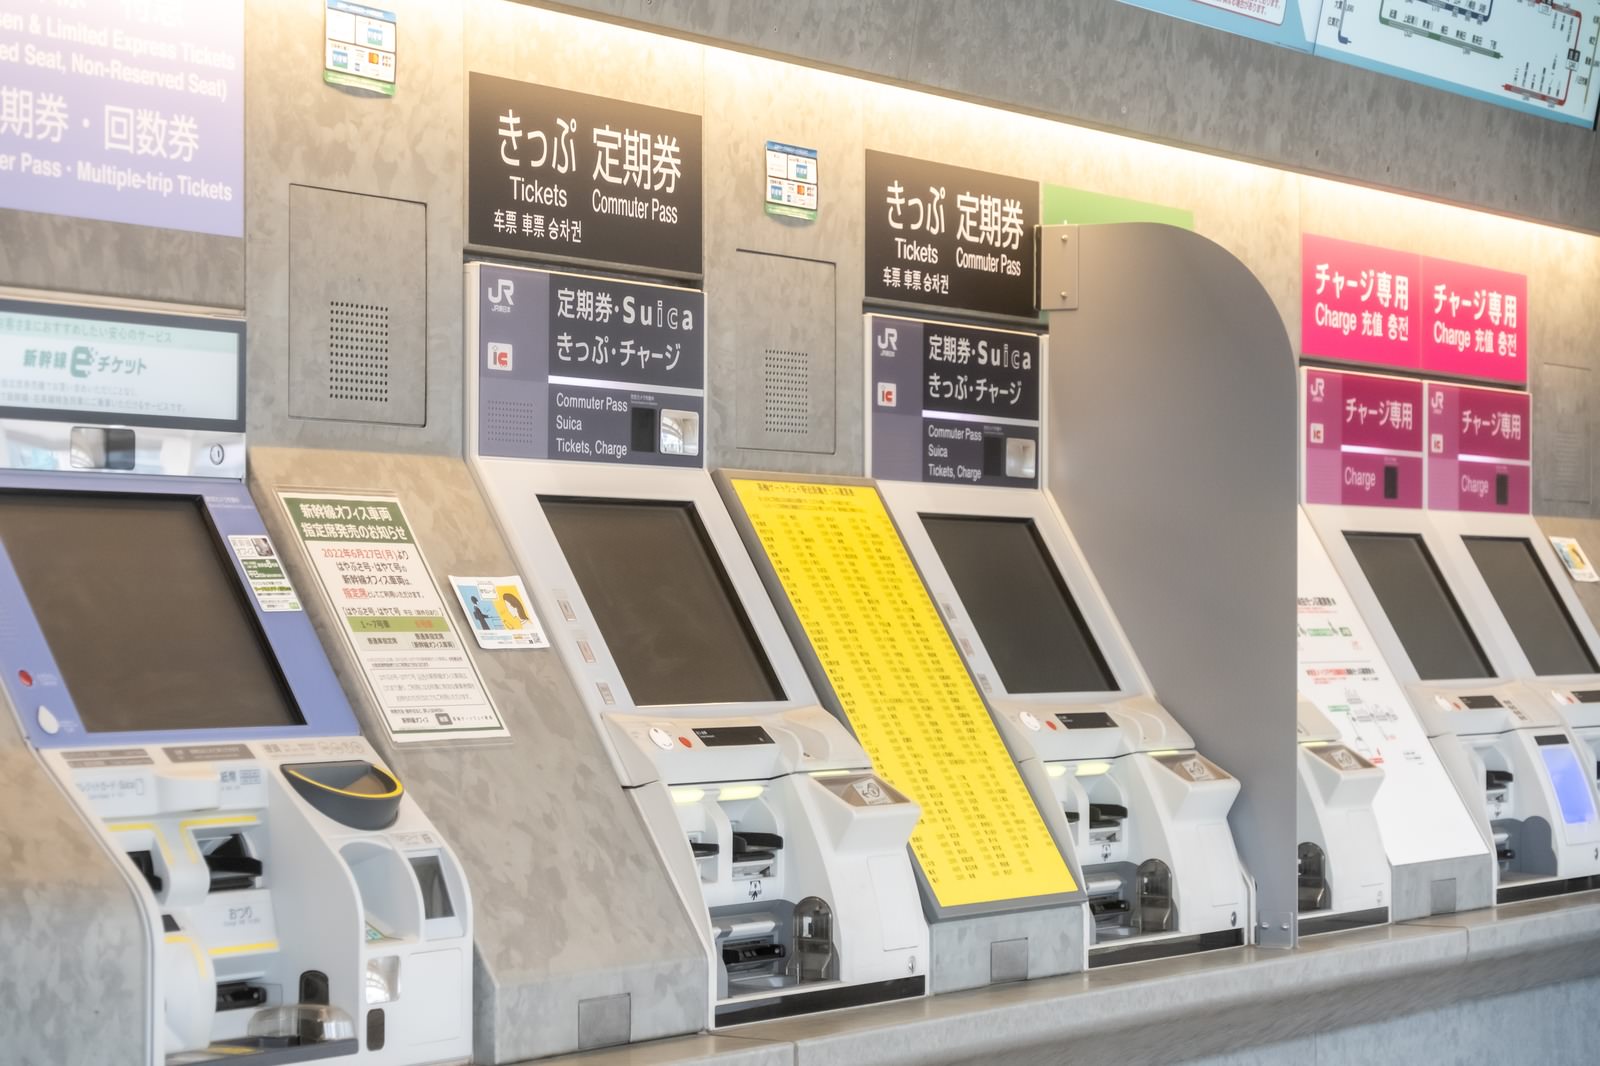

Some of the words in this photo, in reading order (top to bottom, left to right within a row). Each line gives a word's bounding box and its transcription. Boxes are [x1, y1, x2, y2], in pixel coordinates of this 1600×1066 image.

[29, 14, 42, 35] &
[47, 17, 108, 47] Limited
[113, 29, 177, 60] Express
[181, 42, 236, 71] Tickets
[25, 44, 67, 74] Seat,
[72, 52, 184, 91] Non-Reserved
[188, 73, 228, 102] Seat)
[498, 109, 577, 174] きっぷ
[592, 124, 682, 194] 定期券
[21, 153, 62, 178] Pass
[77, 160, 173, 197] Multiple-trip
[177, 174, 232, 201] Tickets
[509, 175, 568, 208] Tickets
[592, 188, 649, 219] Commuter
[651, 198, 678, 224] Pass
[493, 209, 518, 234] 车票
[522, 212, 545, 238] 車票
[548, 217, 582, 243] 승차권
[886, 180, 946, 235] きっぷ
[956, 191, 1024, 250] 定期券
[894, 238, 938, 264] Tickets
[956, 247, 999, 273] Commuter
[1000, 254, 1021, 277] Pass
[488, 279, 514, 306] JR
[904, 269, 922, 291] 車票
[923, 272, 949, 294] 승차권
[1315, 263, 1409, 311] チャージ専用
[1433, 283, 1517, 329] チャージ専用
[1315, 302, 1357, 336] Charge
[1362, 310, 1384, 337] 充值
[1388, 314, 1408, 342] 충전
[1434, 321, 1471, 352] Charge
[556, 332, 681, 371] きっぷ・チャージ
[877, 328, 898, 351] JR
[556, 392, 604, 411] Commuter
[606, 396, 628, 412] Pass
[928, 372, 1022, 405] きっぷ・チャージ
[1310, 378, 1324, 397] JR
[1431, 391, 1444, 409] JR
[556, 415, 582, 431] Suica
[1345, 398, 1413, 431] チャージ専用
[1462, 410, 1522, 440] チャージ専用
[556, 437, 592, 456] Tickets,
[595, 440, 628, 459] Charge
[928, 425, 964, 440] Commuter
[965, 428, 982, 441] Pass
[928, 444, 948, 458] Suica
[928, 463, 955, 480] Tickets,
[957, 465, 982, 482] Charge
[1344, 466, 1376, 490] Charge
[1461, 475, 1489, 496] Charge
[300, 504, 392, 521] 新幹線オフィス車両
[301, 522, 408, 540] 指定席発売のお知らせ
